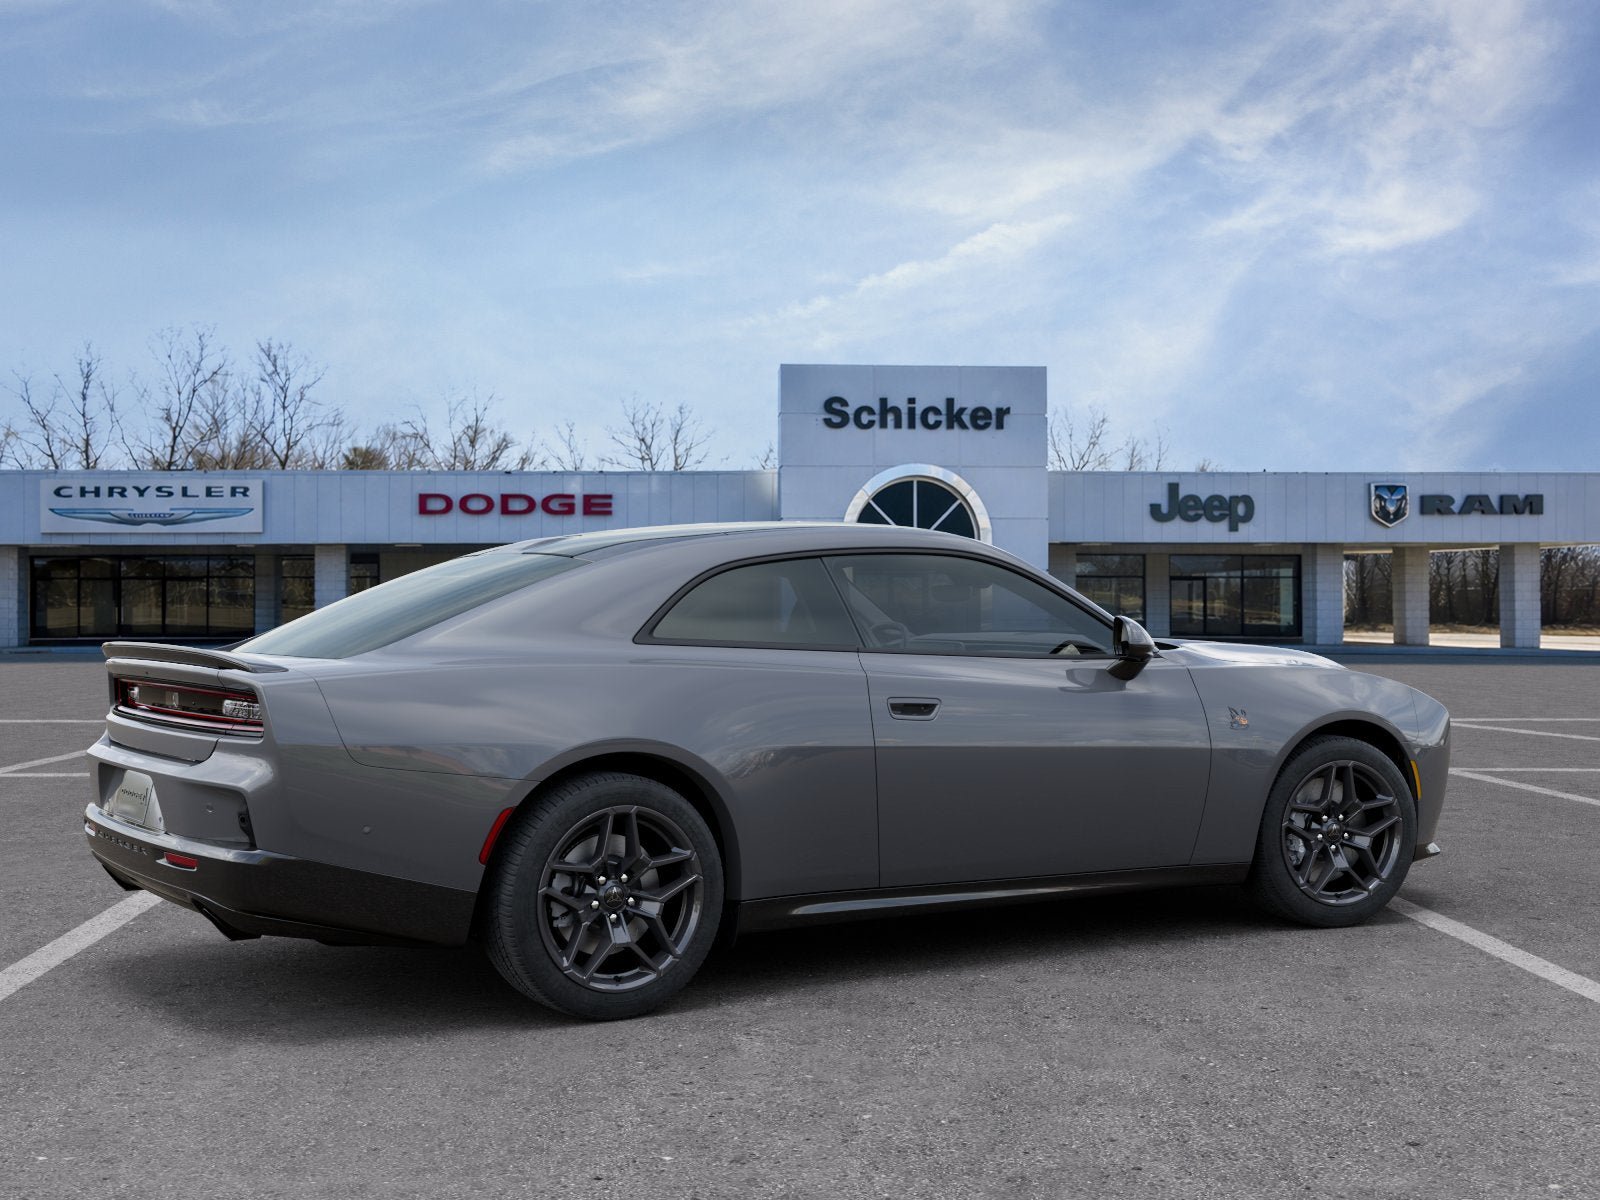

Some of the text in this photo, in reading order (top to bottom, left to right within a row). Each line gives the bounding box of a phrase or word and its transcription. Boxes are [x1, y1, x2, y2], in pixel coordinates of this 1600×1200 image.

[823, 396, 1011, 430] Schicker
[53, 486, 251, 498] CHRYSLER
[418, 493, 613, 515] DODGE
[1149, 482, 1254, 532] Jeep
[1420, 494, 1544, 515] RAM
